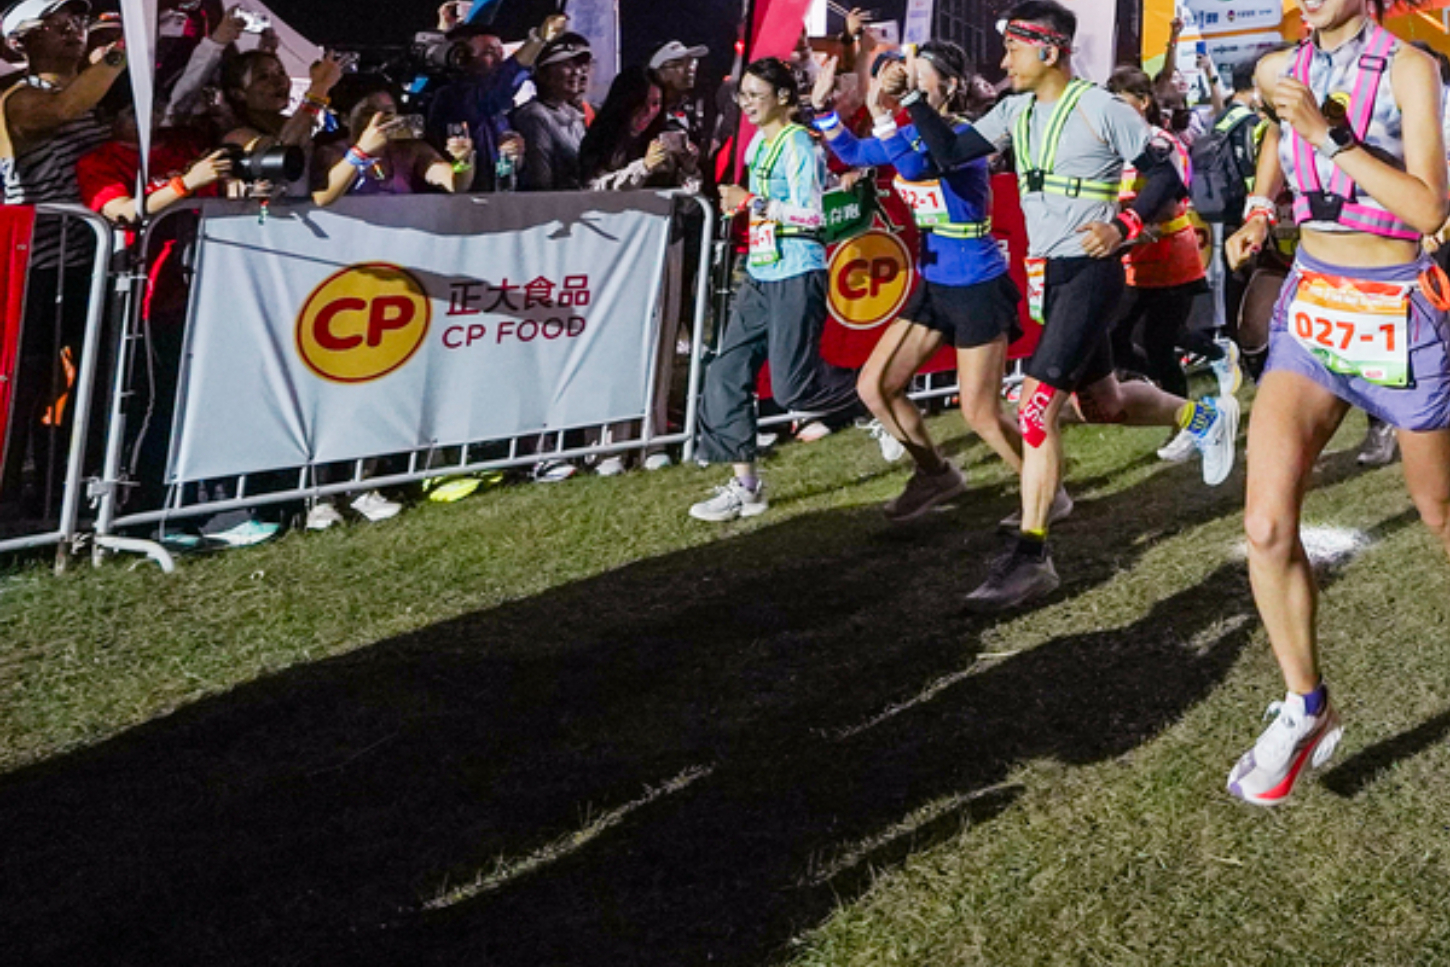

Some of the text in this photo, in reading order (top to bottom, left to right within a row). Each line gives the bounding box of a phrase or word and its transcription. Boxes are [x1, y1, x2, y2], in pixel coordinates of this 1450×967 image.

[445, 274, 590, 316] 正大食品
[837, 257, 900, 301] CP
[312, 295, 416, 351] CP
[442, 316, 586, 349] CP FOOD
[1295, 312, 1396, 352] 027-1
